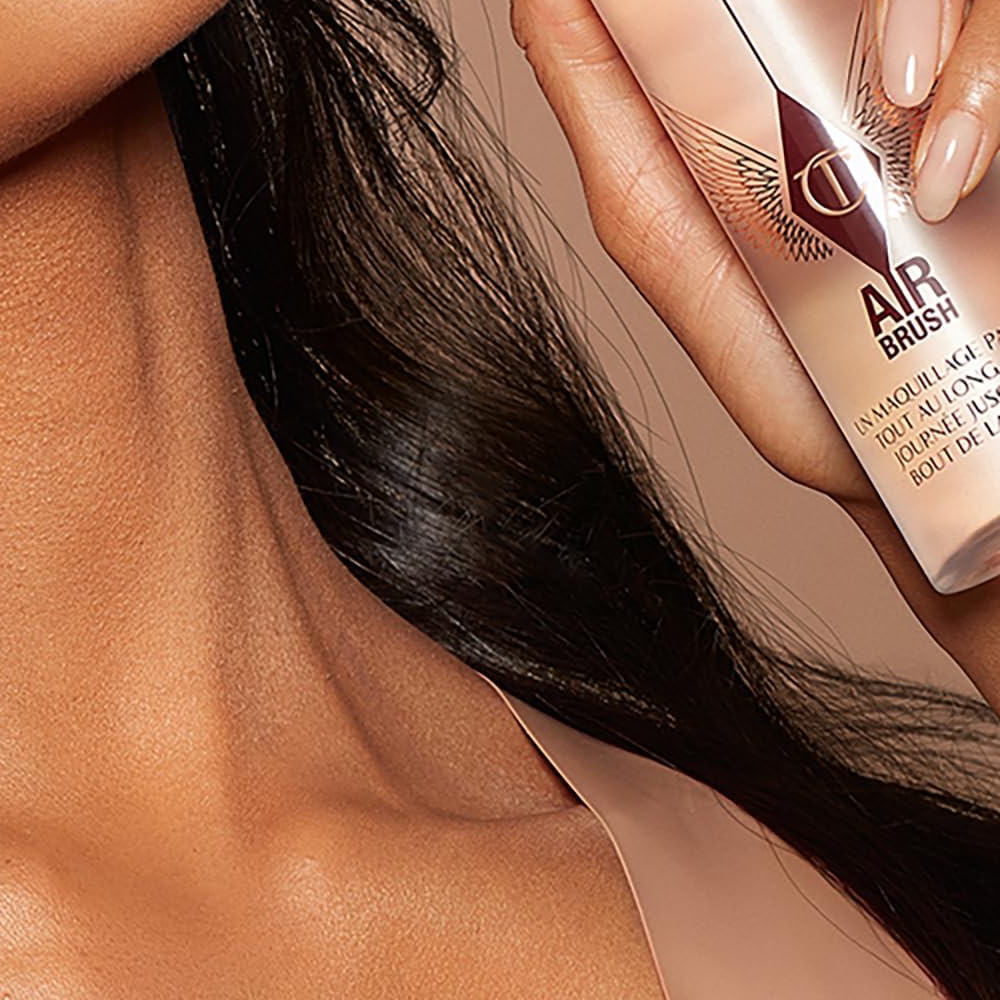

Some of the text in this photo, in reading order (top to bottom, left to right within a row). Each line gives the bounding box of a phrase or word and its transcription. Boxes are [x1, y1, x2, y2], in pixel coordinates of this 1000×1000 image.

[860, 256, 947, 337] AIR
[878, 298, 960, 361] BRUSH
[871, 340, 983, 423] MAQUILLAGE
[874, 360, 1000, 449] TOUT AU LONG
[894, 408, 967, 471] JOURNÉE
[909, 445, 956, 487] BOUT
[956, 427, 984, 454] DE
